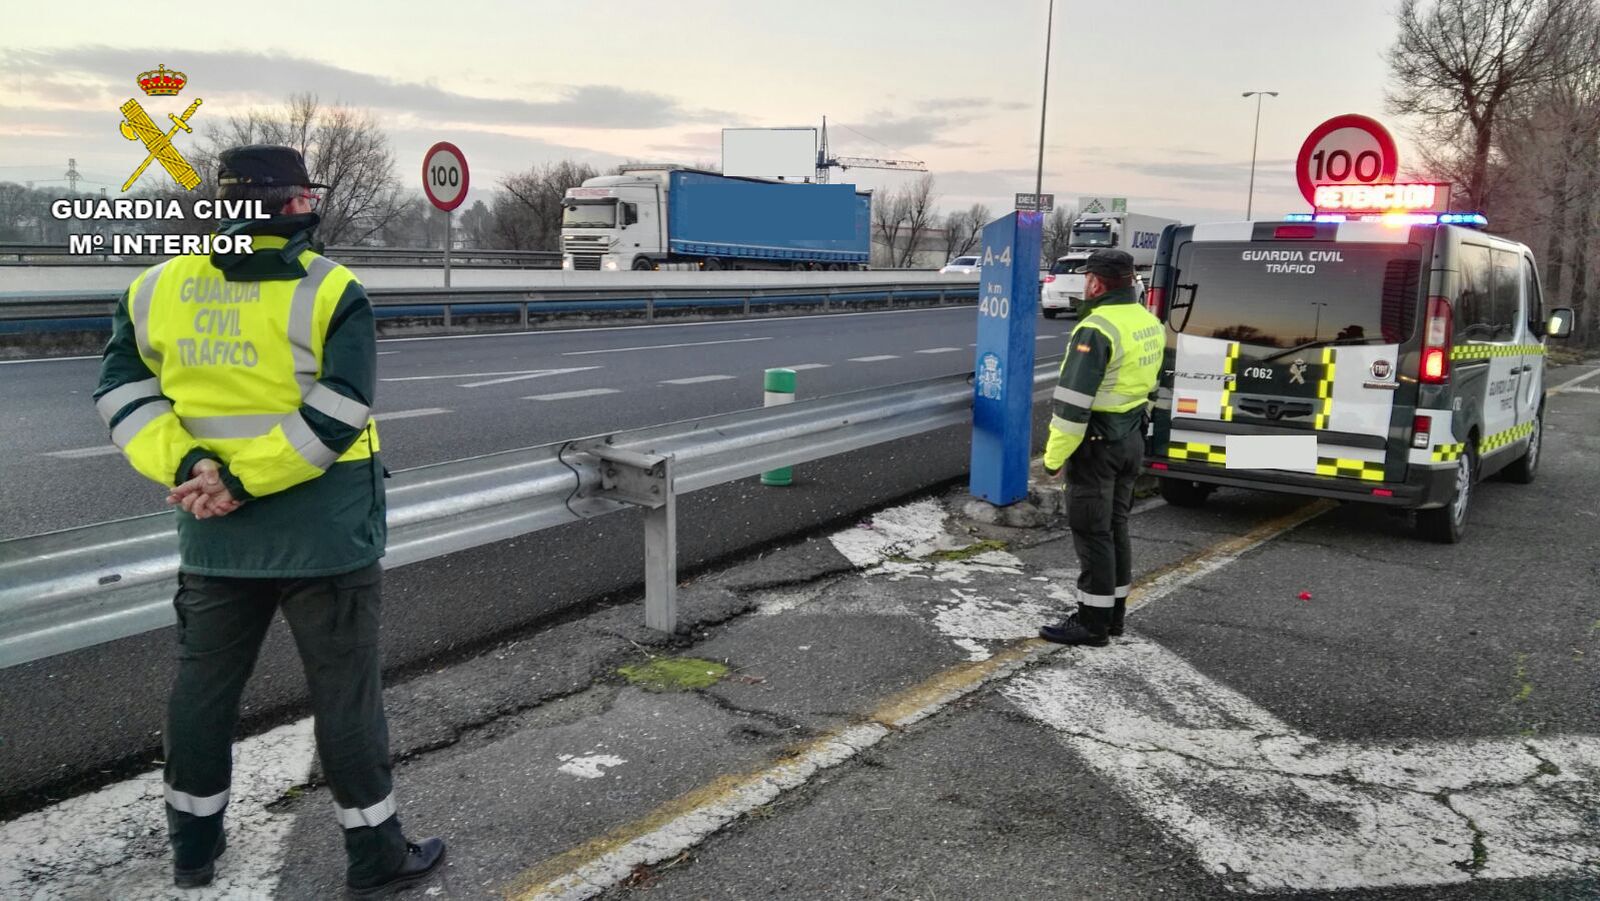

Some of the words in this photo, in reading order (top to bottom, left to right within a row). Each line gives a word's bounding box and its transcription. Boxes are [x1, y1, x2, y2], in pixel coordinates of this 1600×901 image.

[1313, 149, 1382, 182] 100
[431, 166, 459, 187] 100
[983, 246, 1011, 266] A-4
[1242, 250, 1303, 261] GUARDIA
[1309, 251, 1344, 262] CIVIL
[1266, 262, 1316, 274] TRÁFICO
[180, 276, 261, 304] GUARDIA
[987, 282, 1002, 294] km
[980, 296, 1009, 318] 400
[193, 308, 241, 336] CIVIL
[1165, 370, 1235, 382] TALENTO
[1252, 367, 1273, 380] 062
